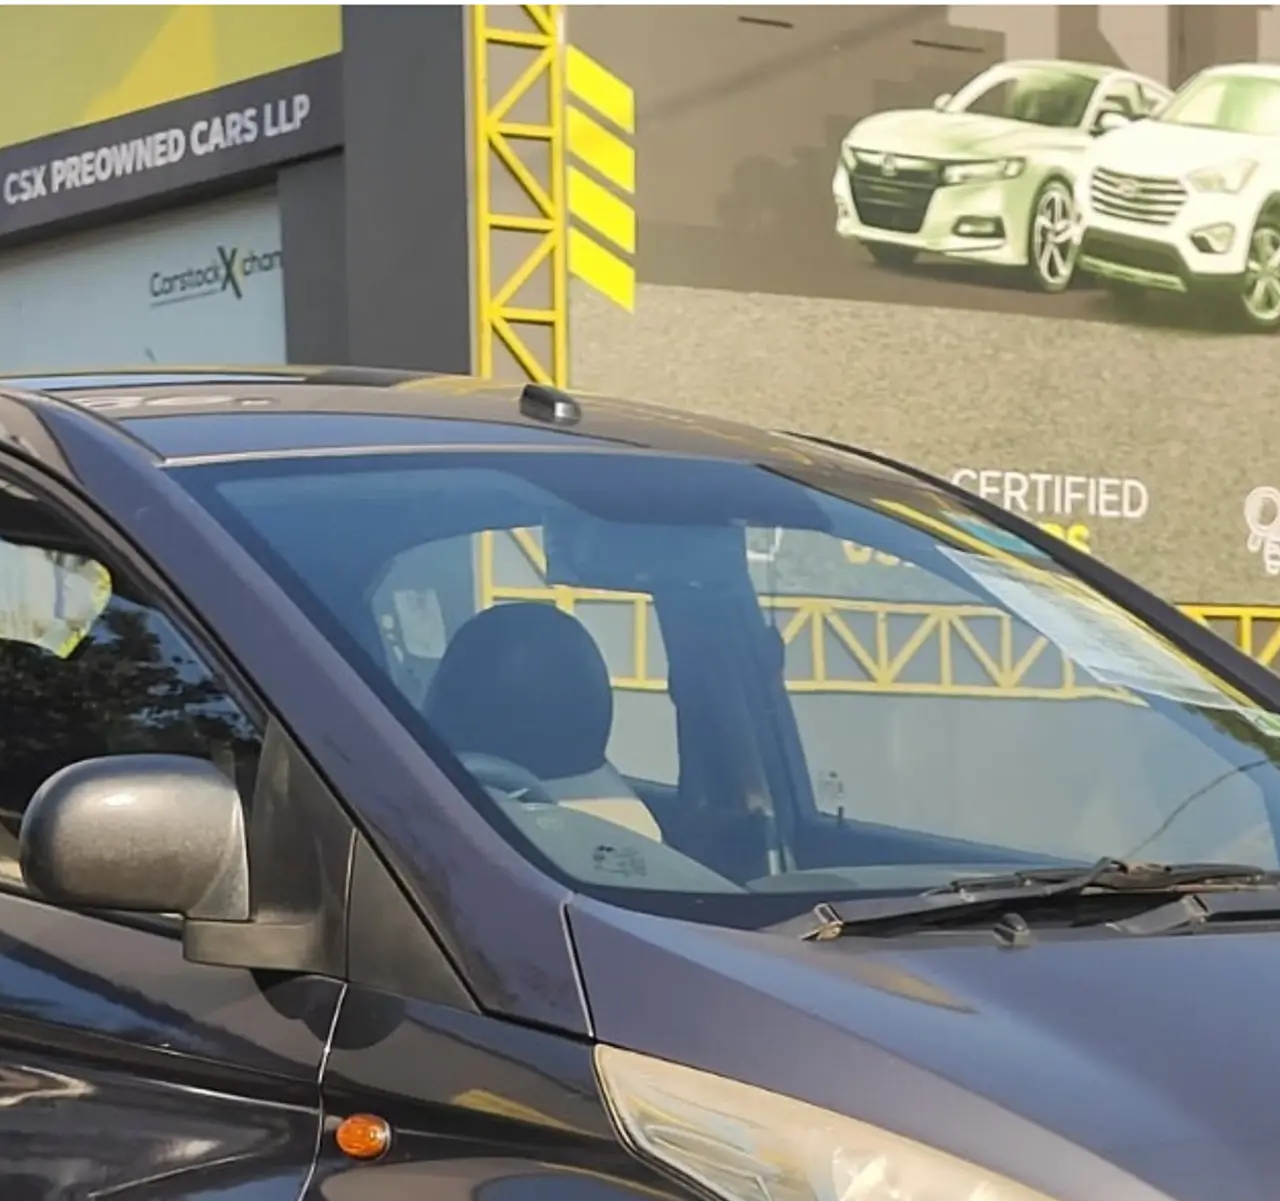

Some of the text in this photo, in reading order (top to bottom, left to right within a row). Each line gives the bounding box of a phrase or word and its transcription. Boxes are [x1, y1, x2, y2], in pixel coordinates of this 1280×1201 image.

[3, 94, 311, 204] CSX PREOWNED CARS LLP
